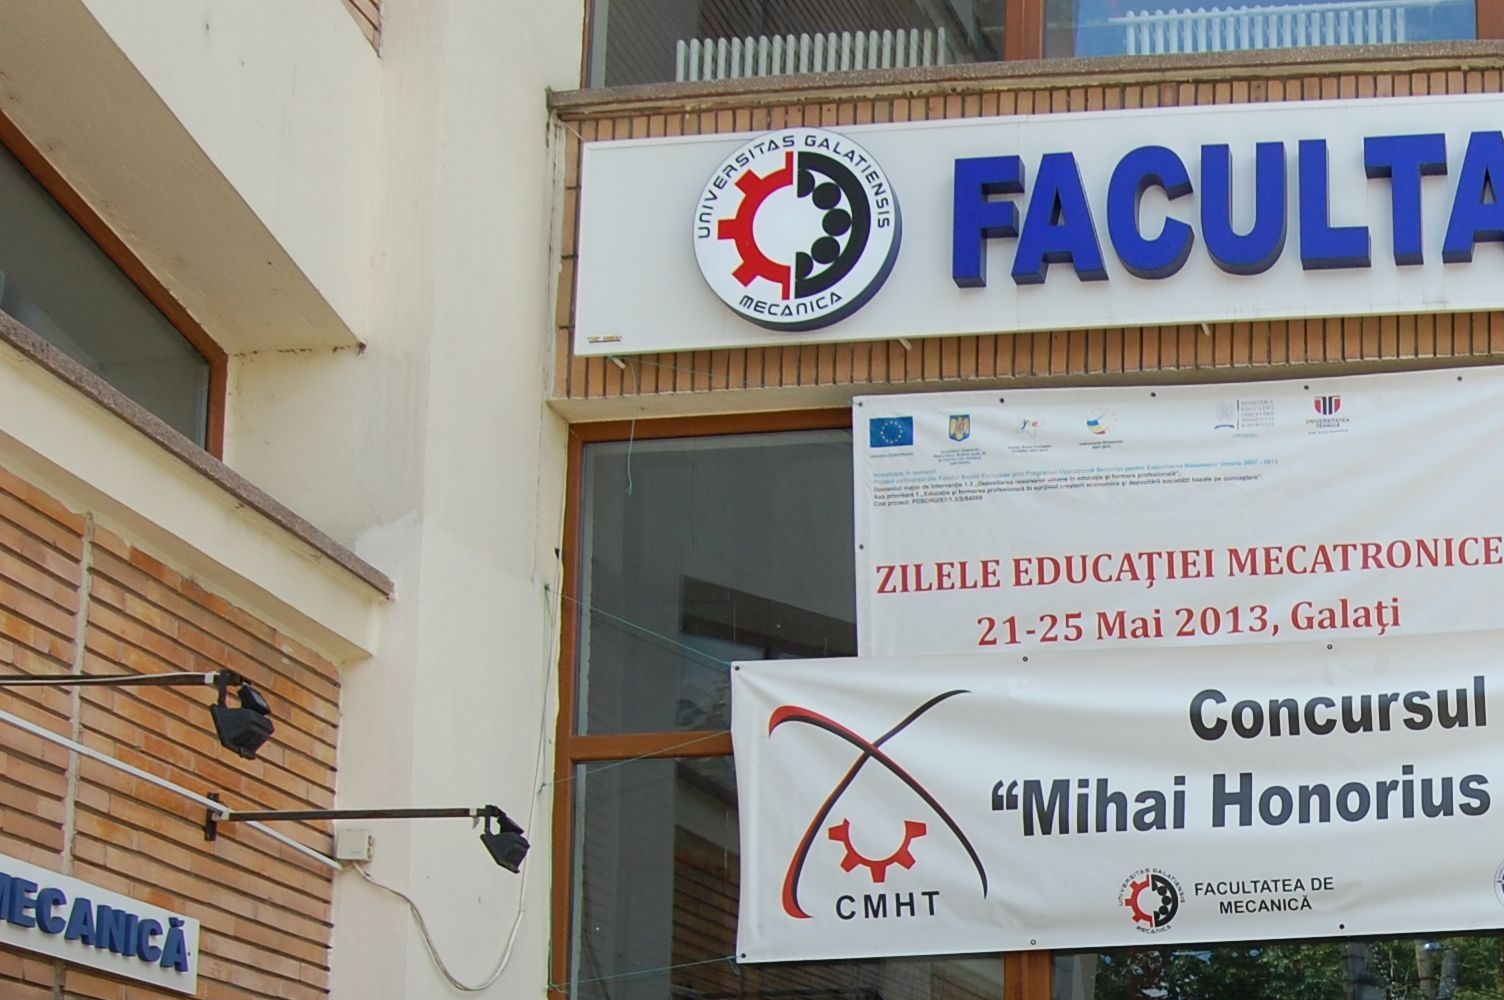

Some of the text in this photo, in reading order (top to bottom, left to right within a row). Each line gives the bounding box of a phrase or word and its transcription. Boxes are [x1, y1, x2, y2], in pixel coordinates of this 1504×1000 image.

[697, 134, 890, 239] UNIVERSITAS GALATIENSIS
[739, 291, 842, 317] MECANICA
[876, 559, 1001, 594] ZILELE
[1228, 536, 1504, 576] MECATRONICE
[977, 612, 1083, 646] 21-25
[1097, 609, 1164, 640] Mai
[1175, 604, 1279, 637] 2013,
[1189, 675, 1487, 741] Concursul
[1212, 764, 1491, 828] Honorius
[836, 890, 940, 920] CMHT
[1194, 876, 1334, 896] FACULTATEA DE
[1219, 895, 1313, 914] MECANICĂ
